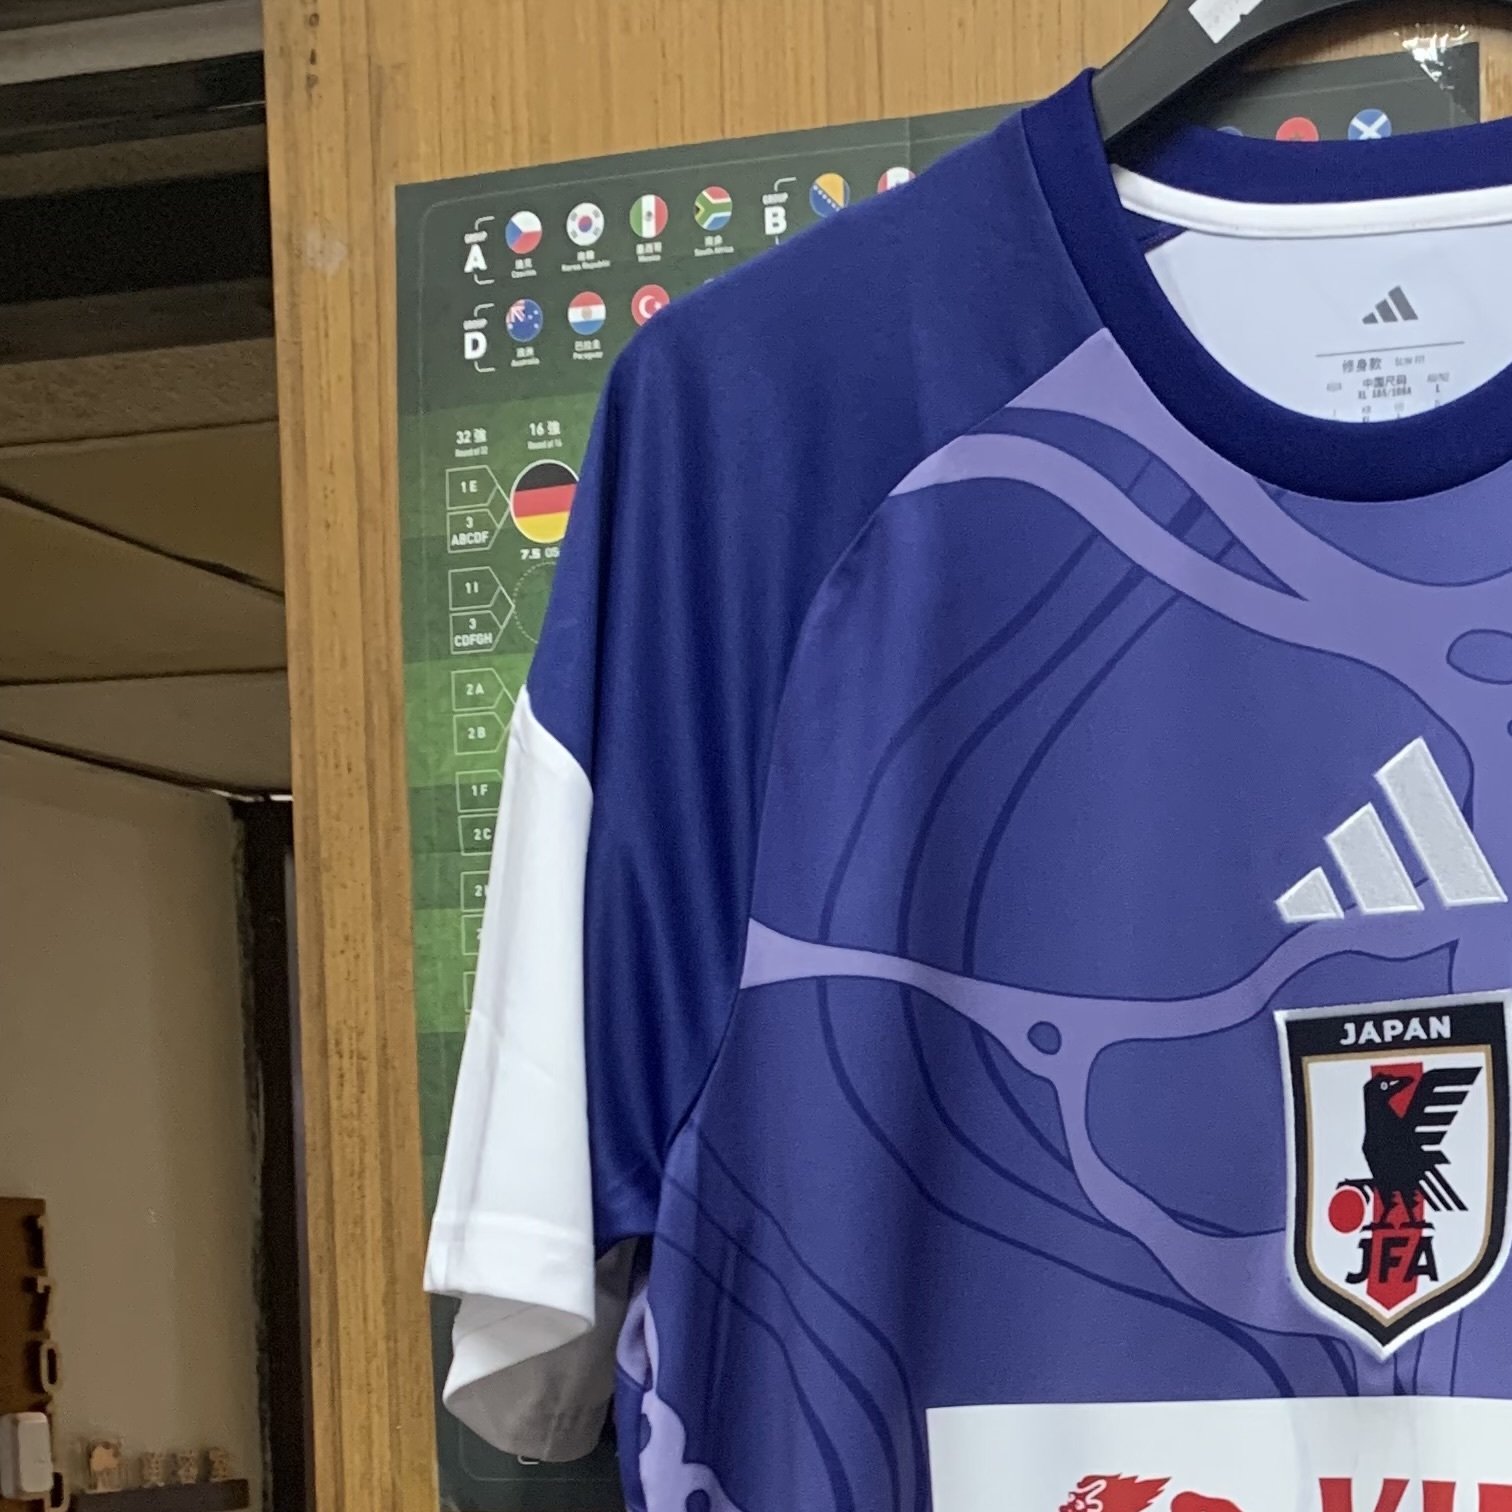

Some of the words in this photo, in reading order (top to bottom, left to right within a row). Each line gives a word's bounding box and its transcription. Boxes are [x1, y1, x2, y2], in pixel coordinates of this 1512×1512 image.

[764, 205, 787, 235] B
[464, 244, 487, 273] A
[464, 331, 487, 360] D
[465, 516, 474, 529] 3
[469, 618, 477, 630] 3
[1340, 1015, 1452, 1046] JAPAN
[1346, 1235, 1439, 1284] JFA
